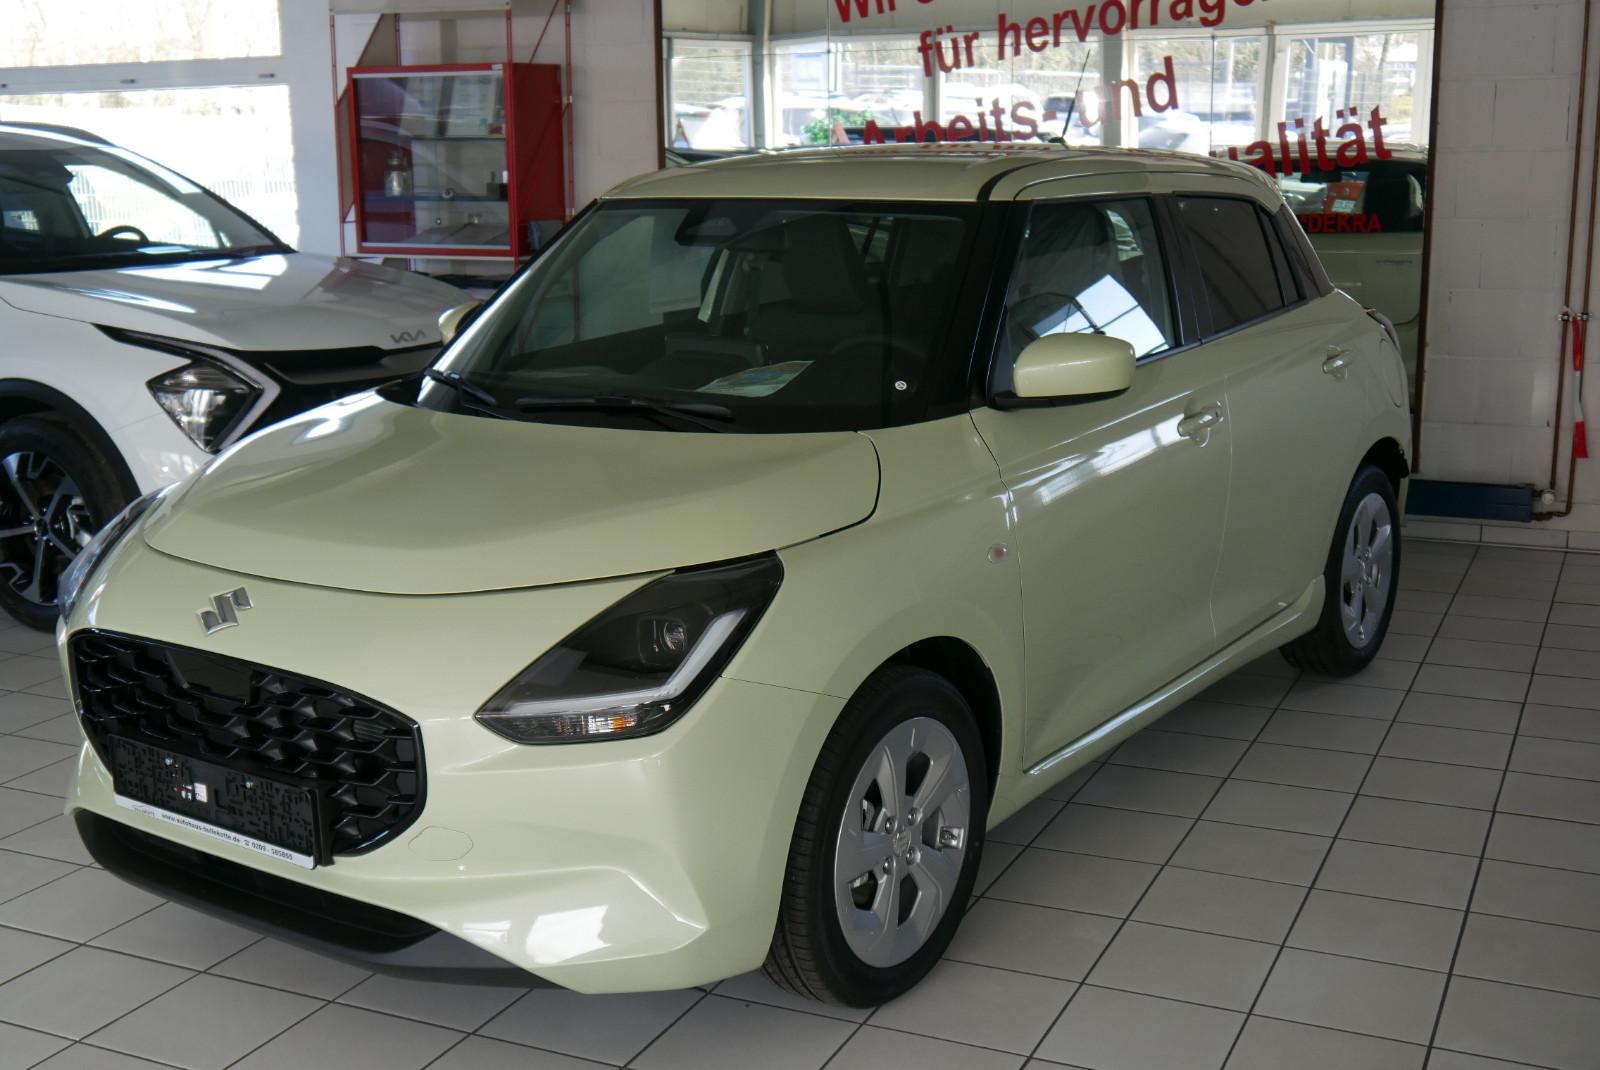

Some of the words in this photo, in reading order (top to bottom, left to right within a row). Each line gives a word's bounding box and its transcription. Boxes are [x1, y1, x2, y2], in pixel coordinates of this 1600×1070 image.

[918, 25, 979, 77] für
[1076, 55, 1179, 128] und
[1307, 212, 1383, 234] DEKRA
